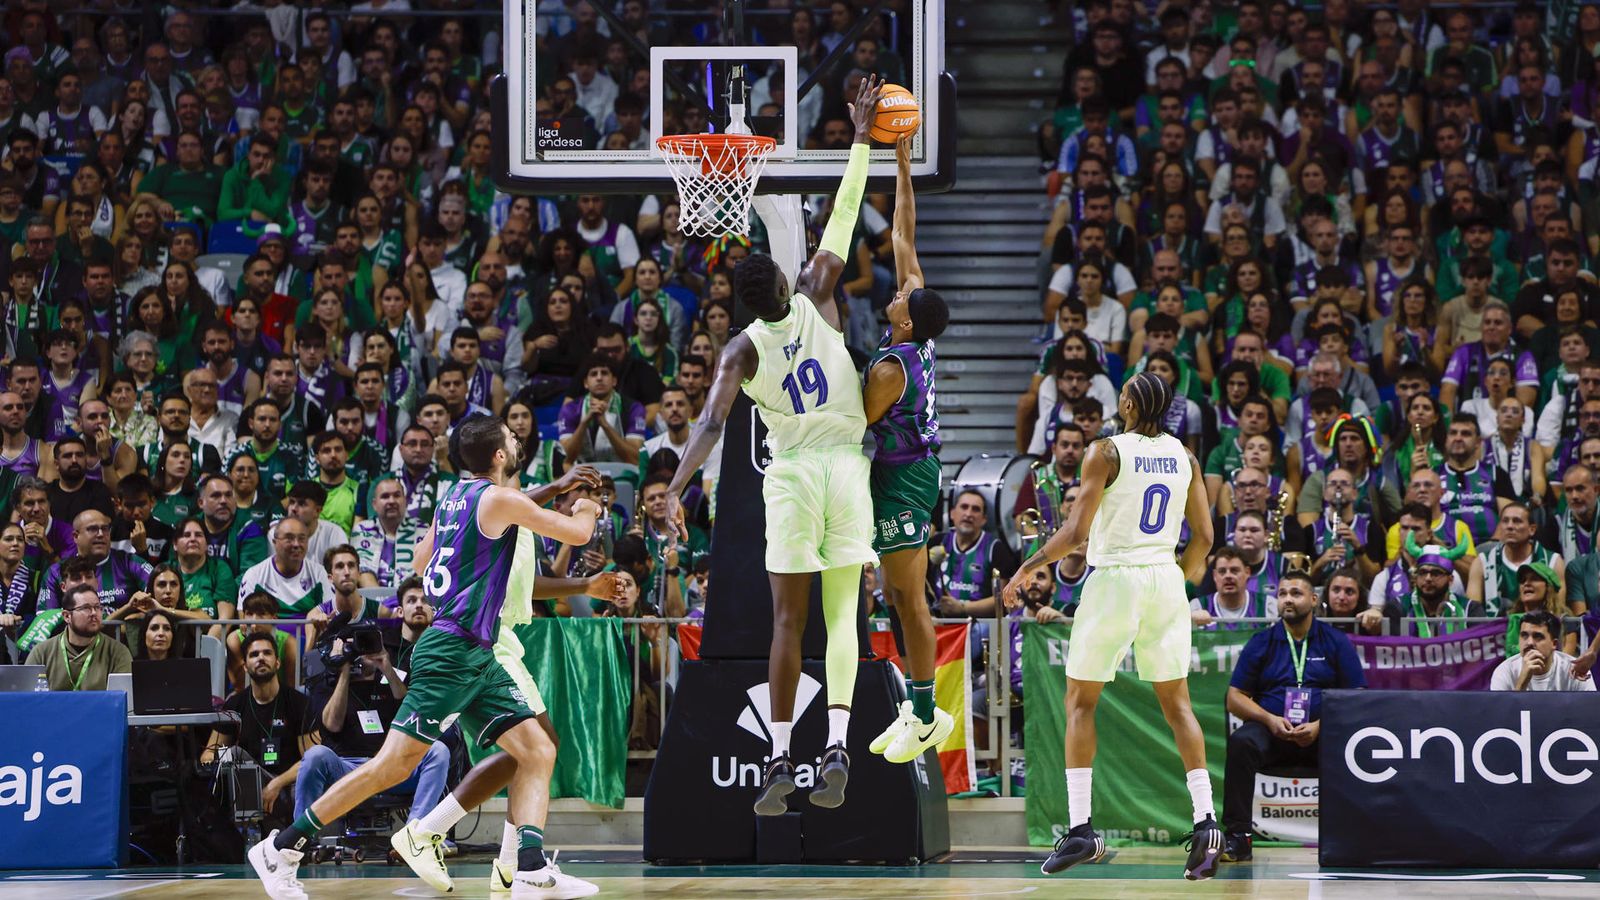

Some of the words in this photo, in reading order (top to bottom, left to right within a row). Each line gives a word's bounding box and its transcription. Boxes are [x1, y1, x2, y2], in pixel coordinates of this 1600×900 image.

[538, 127, 559, 139] liga
[538, 137, 583, 147] endesa
[781, 358, 829, 415] 19
[1134, 456, 1179, 474] PUNTER
[1139, 483, 1172, 535] 0
[422, 546, 455, 598] 45
[1375, 634, 1506, 670] BALONCES
[1344, 710, 1600, 785] ende
[1261, 779, 1319, 798] Unica
[1261, 806, 1320, 819] Balonce
